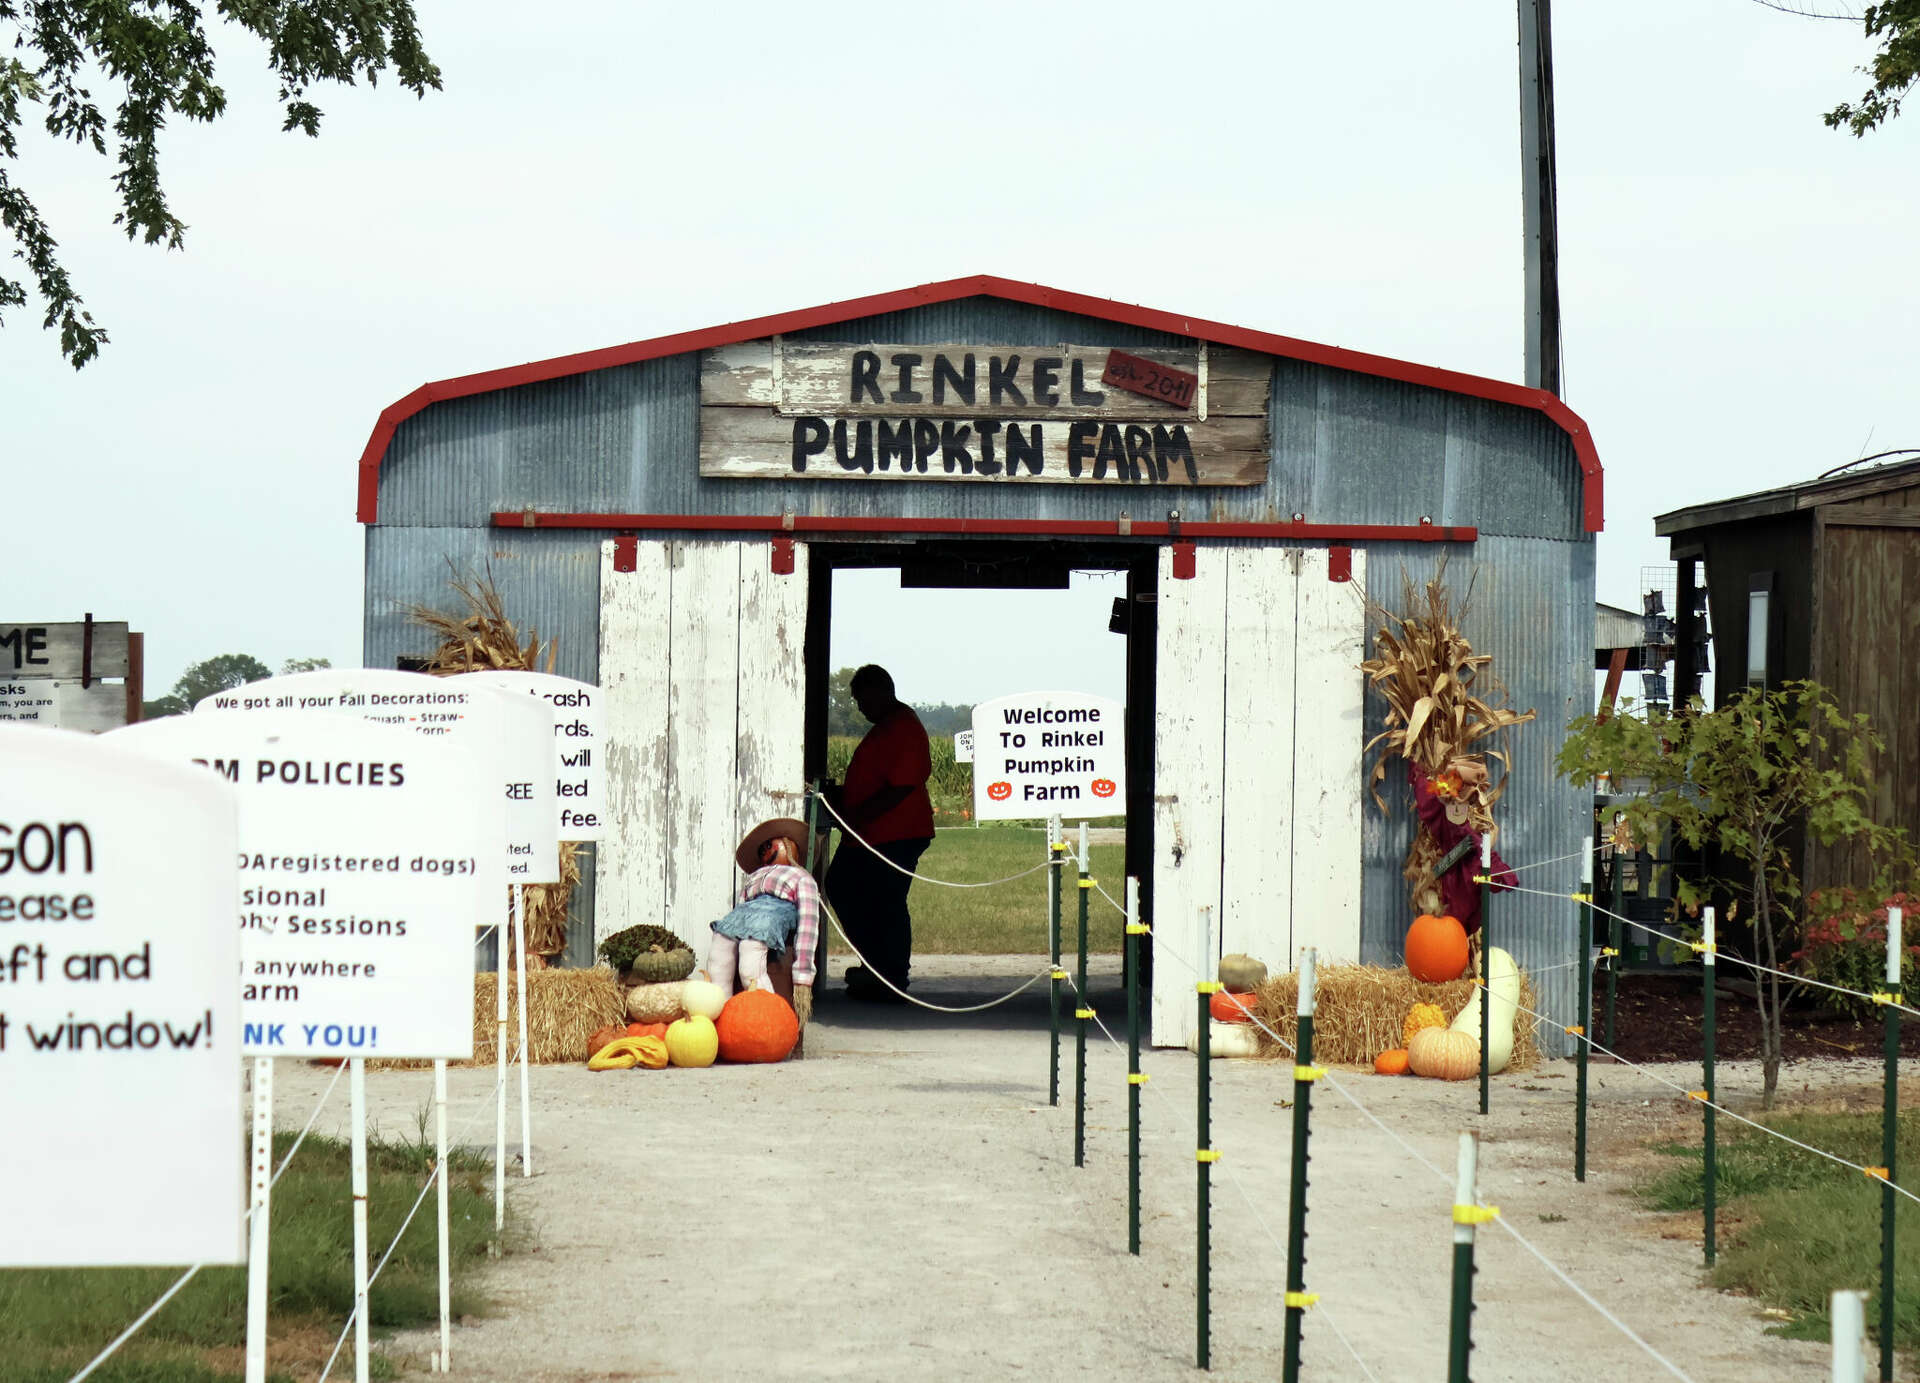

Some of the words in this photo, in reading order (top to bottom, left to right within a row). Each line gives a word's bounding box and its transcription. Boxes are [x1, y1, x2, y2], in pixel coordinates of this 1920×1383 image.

[849, 350, 1105, 408] RINKEL
[791, 416, 1044, 476] PUMPKIN
[1067, 421, 1200, 485] FARM
[14, 699, 33, 708] you
[215, 697, 239, 709] We
[243, 696, 270, 711] got
[275, 694, 294, 707] all
[299, 695, 334, 710] your
[339, 694, 366, 706] Fall
[371, 691, 470, 705] Decorations:
[543, 689, 591, 707] ash
[19, 712, 39, 720] and
[1003, 707, 1101, 725] Welcome
[555, 719, 594, 737] rds.
[1041, 730, 1104, 747] Rinkel
[561, 749, 591, 767] will
[1005, 756, 1095, 775] Pumpkin
[256, 760, 406, 786] POLICIES
[1023, 784, 1081, 801] Farm
[561, 809, 602, 827] fee.
[507, 843, 534, 856] ted,
[410, 856, 477, 876] dogs)
[508, 862, 531, 874] ed.
[243, 886, 326, 907] sional
[0, 893, 95, 922] ease
[288, 915, 408, 936] Sessions
[0, 943, 48, 982] ft
[63, 941, 152, 982] and
[254, 960, 377, 978] anywhere
[243, 984, 299, 1001] arm
[26, 1009, 213, 1052] window!
[244, 1023, 285, 1045] NK
[302, 1024, 379, 1047] YOU!
